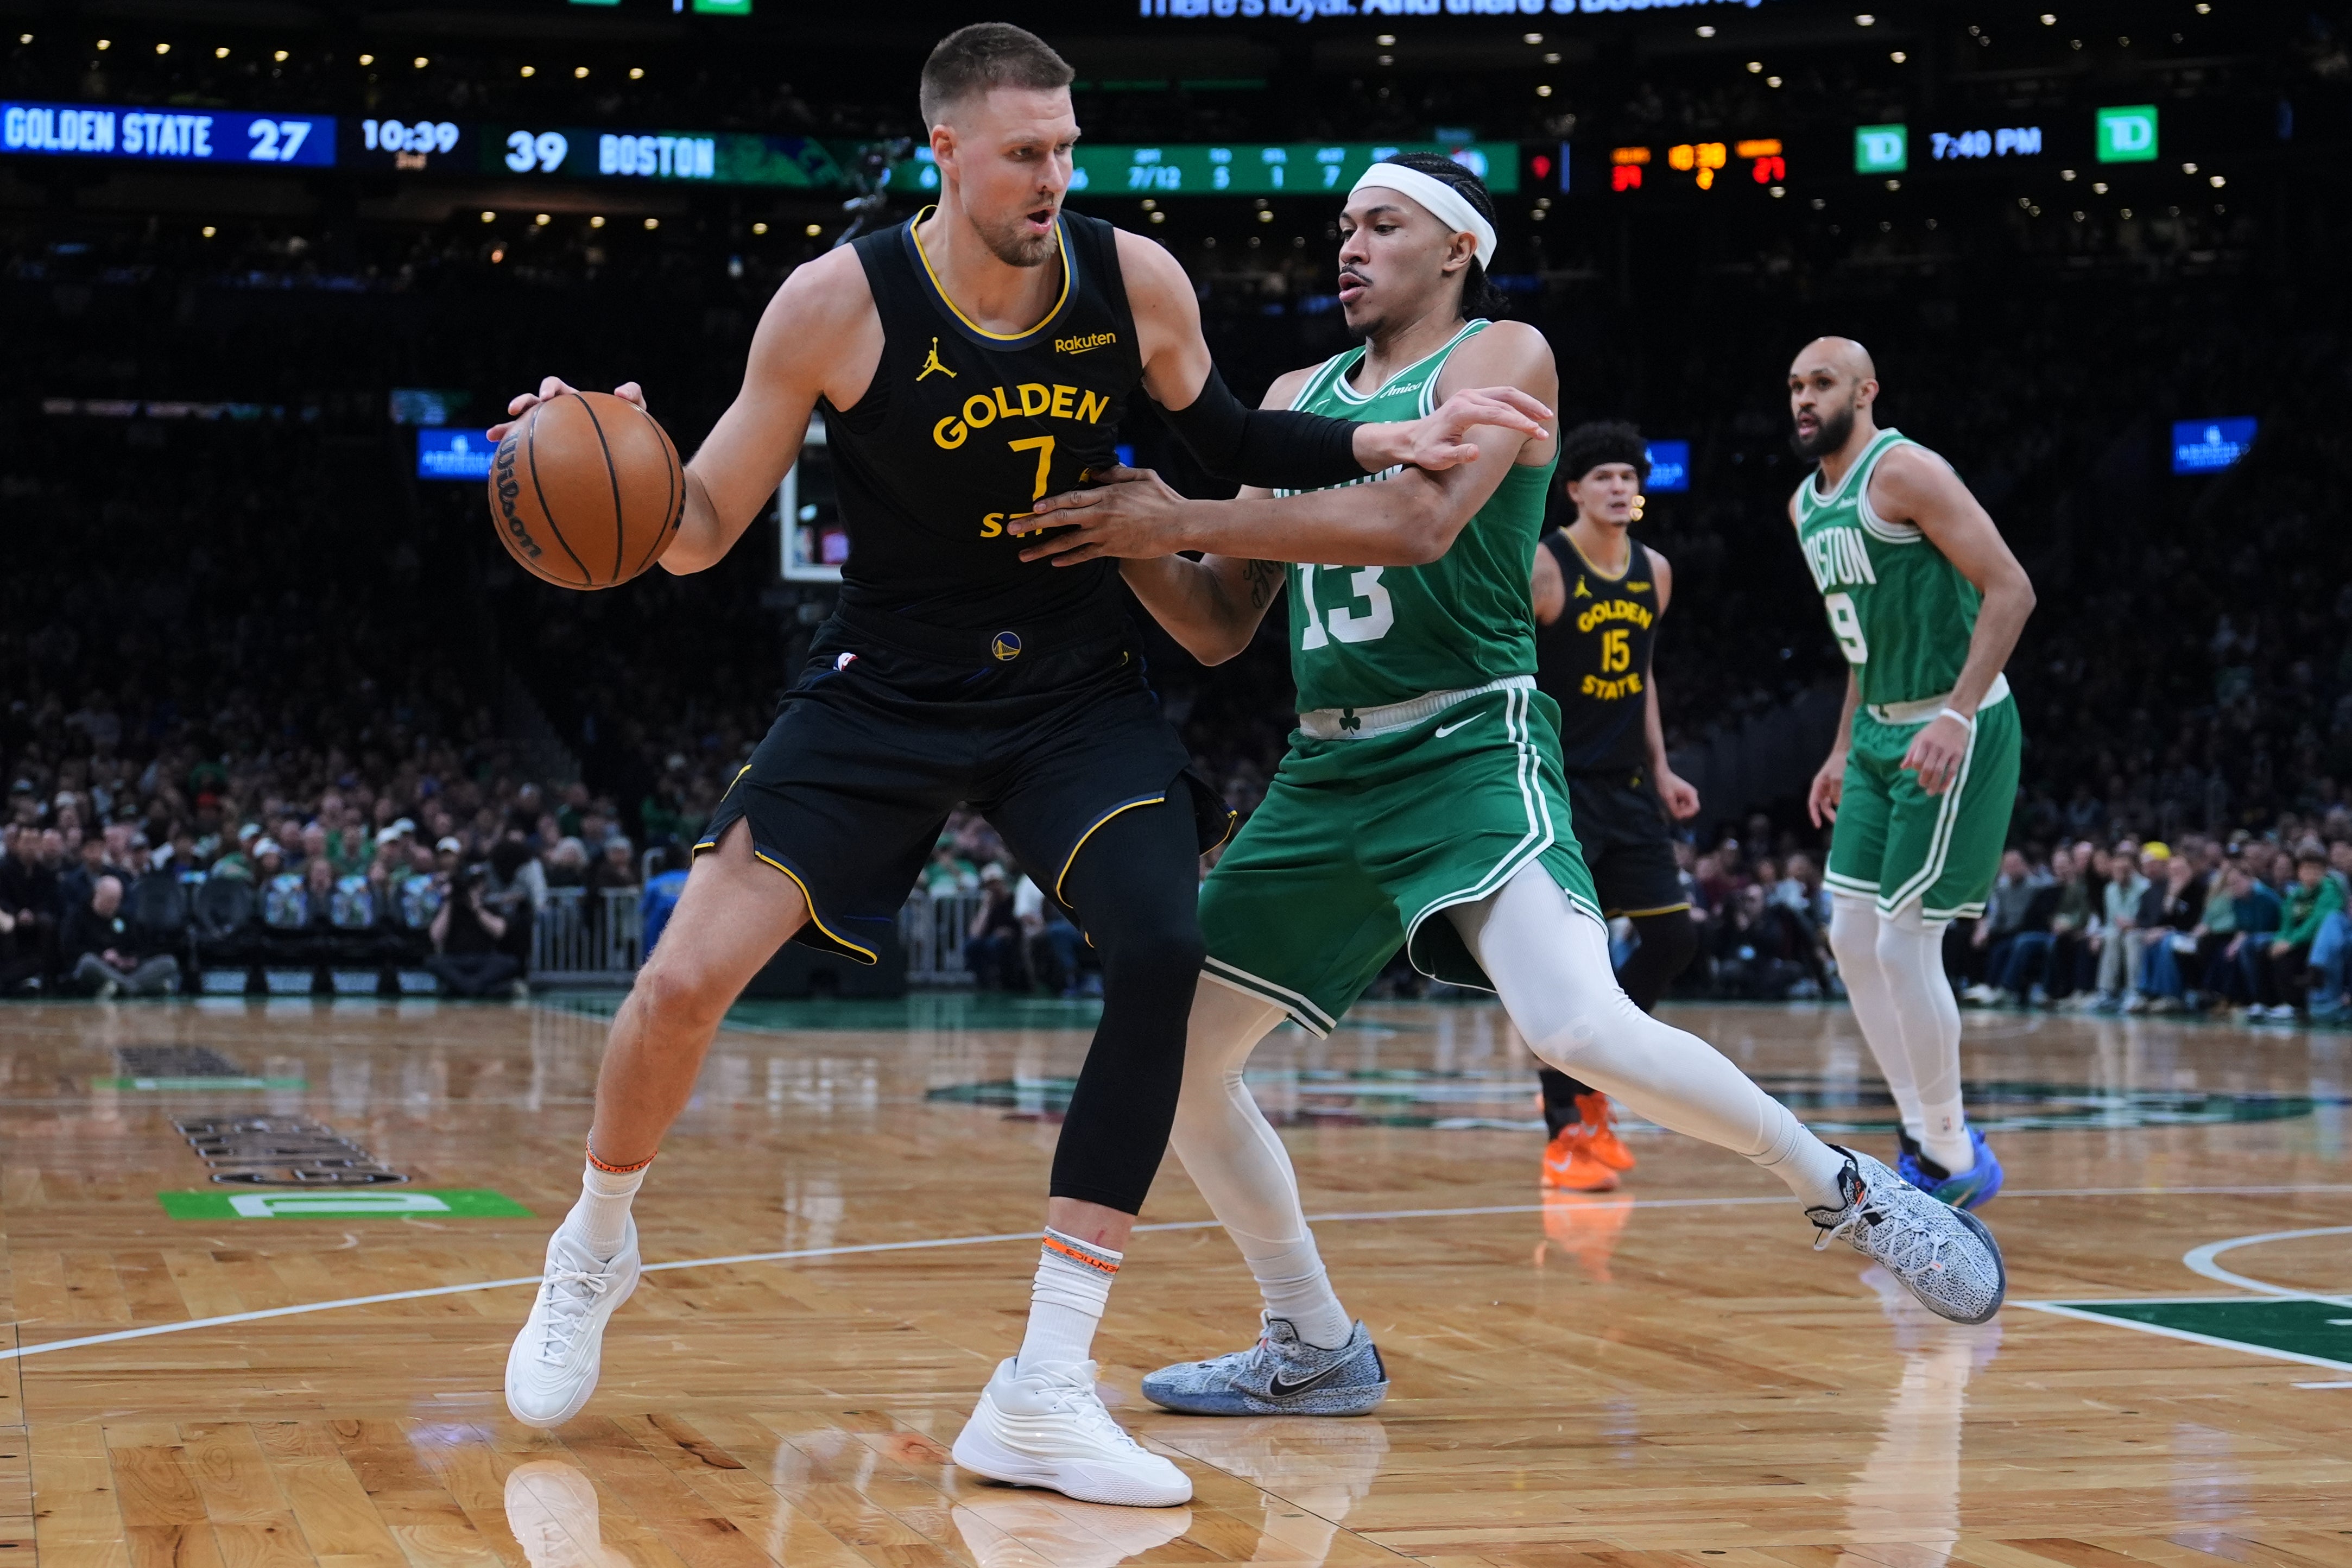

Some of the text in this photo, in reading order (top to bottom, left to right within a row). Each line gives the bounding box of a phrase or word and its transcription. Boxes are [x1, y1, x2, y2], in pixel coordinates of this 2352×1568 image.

[4, 107, 213, 157] GOLDEN STATE
[248, 118, 312, 162] 27
[362, 119, 460, 154] 10:39
[505, 130, 568, 173] 39
[1861, 132, 1901, 163] TD
[1930, 127, 2041, 160] 7:40 PM
[2104, 115, 2152, 152] TD
[599, 134, 715, 178] BOSTON
[1055, 332, 1116, 353] Rakuten
[1380, 382, 1422, 399] Amica
[933, 383, 1110, 450] GOLDEN
[1008, 435, 1055, 502] 7
[1801, 526, 1877, 593] OSTON
[1297, 562, 1394, 650] 13
[1578, 599, 1653, 633] GOLDEN
[1825, 592, 1868, 664] 9
[1602, 628, 1630, 673] 15
[1581, 672, 1643, 701] STATE
[1065, 1248, 1120, 1273] ENTICS
